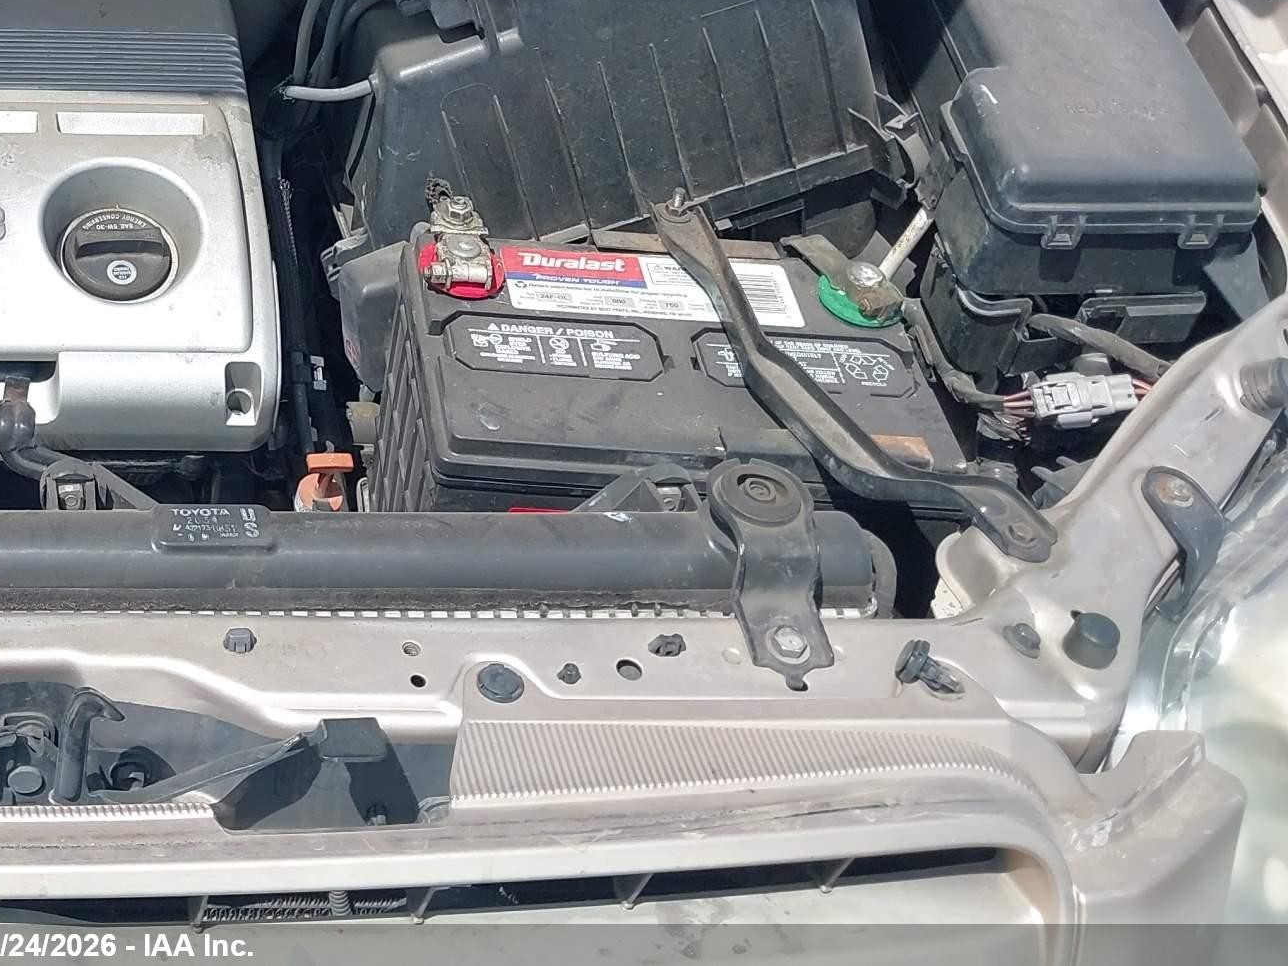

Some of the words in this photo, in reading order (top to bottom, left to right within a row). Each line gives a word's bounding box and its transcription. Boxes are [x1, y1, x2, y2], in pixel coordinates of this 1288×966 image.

[121, 214, 147, 228] ENERGY
[517, 251, 626, 273] Duralast
[532, 273, 580, 284] PROVEN
[582, 278, 620, 287] TOUGH
[500, 323, 553, 336] DANGER
[566, 328, 615, 339] POISON
[170, 508, 231, 517] TOYOTA
